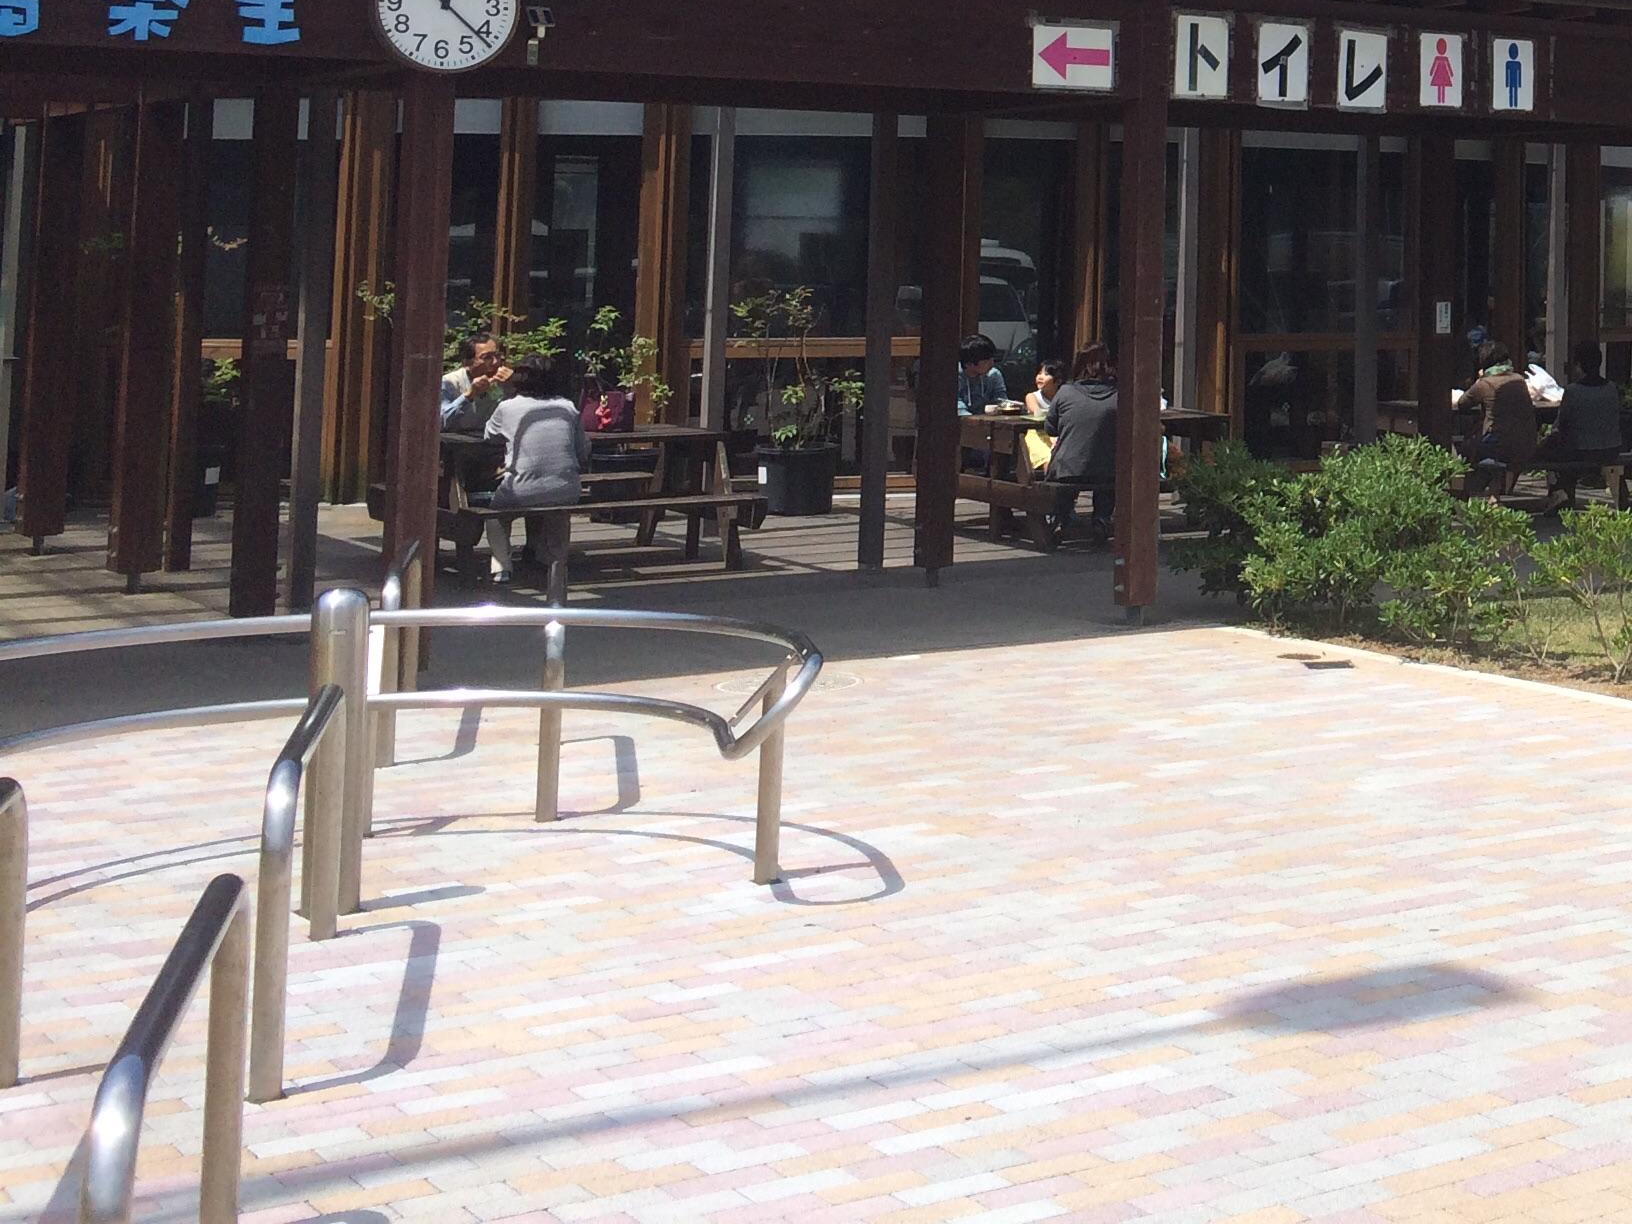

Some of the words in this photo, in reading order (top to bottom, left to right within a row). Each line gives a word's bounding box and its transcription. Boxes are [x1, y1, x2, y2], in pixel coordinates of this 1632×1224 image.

[394, 14, 409, 33] 8
[477, 20, 492, 38] 4
[413, 34, 428, 52] 7
[434, 40, 449, 59] 6
[459, 36, 474, 54] 5
[1189, 23, 1383, 103] トイレ
